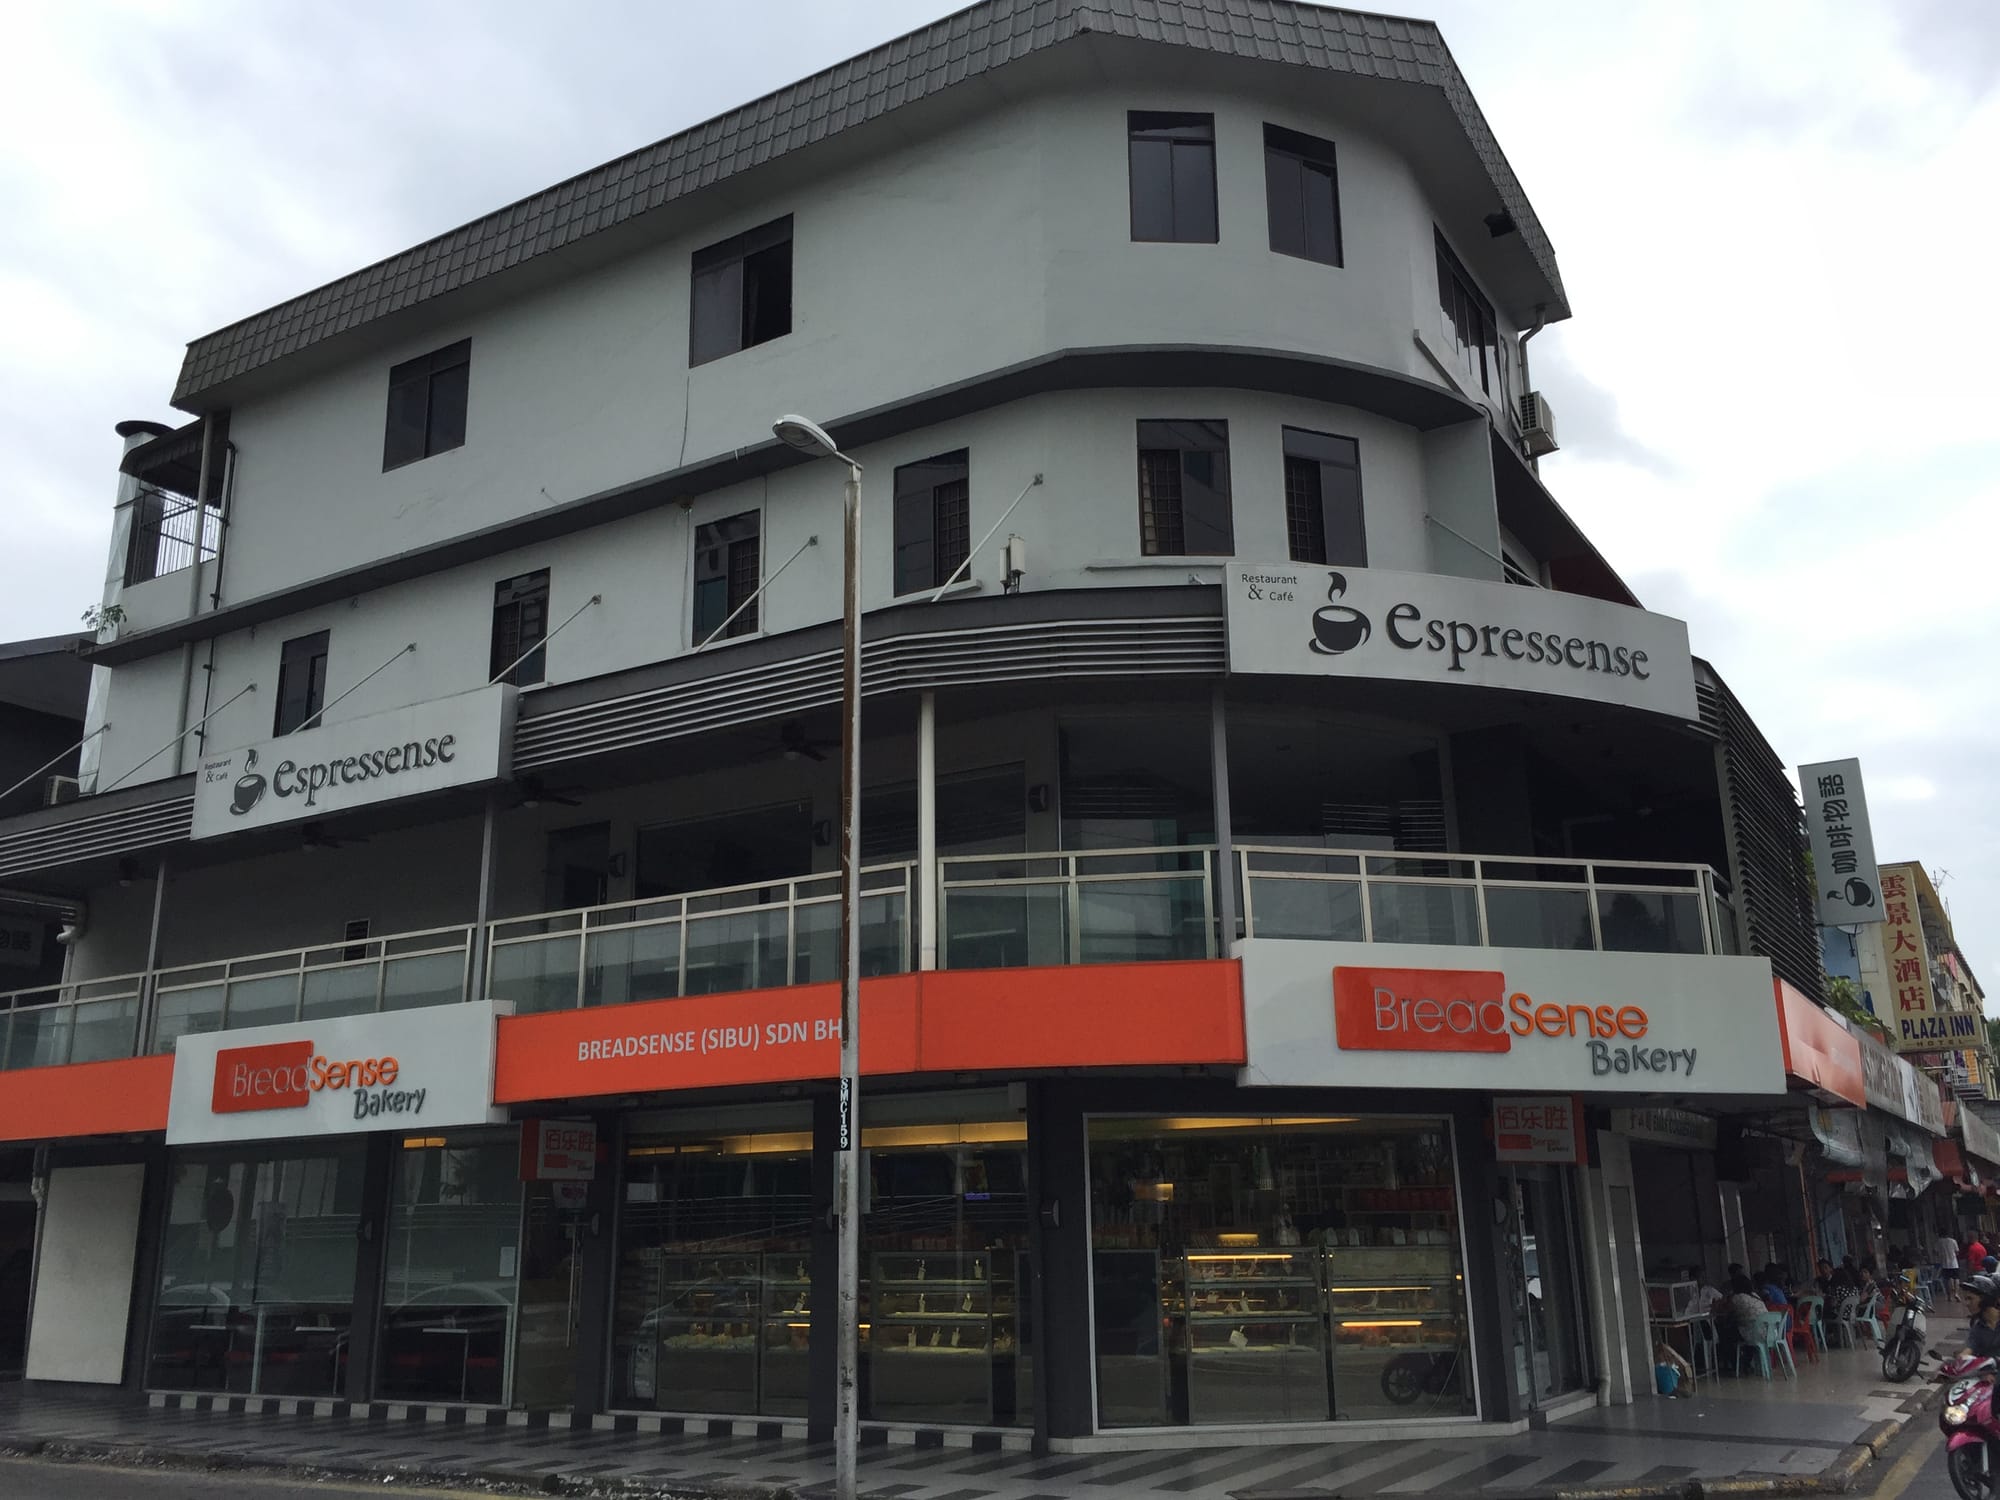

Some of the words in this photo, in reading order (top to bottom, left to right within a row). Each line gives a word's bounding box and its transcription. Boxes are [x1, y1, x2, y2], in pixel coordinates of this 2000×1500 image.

[1241, 573, 1298, 586] Restaurant
[1248, 583, 1264, 601] &
[1269, 590, 1294, 603] Café
[1386, 602, 1651, 681] espressense
[273, 733, 457, 807] espressense
[1880, 874, 1927, 1012] 雲景大酒店
[577, 1031, 696, 1062] BREADSENSE
[700, 1023, 761, 1055] (SIBU)
[765, 1020, 808, 1046] SDN
[814, 1018, 842, 1041] BH
[1901, 1017, 1948, 1040] PLAZA
[1951, 1014, 1976, 1037] INN
[1916, 1039, 1964, 1048] HOTEL
[1586, 1040, 1698, 1077] Bakery
[353, 1088, 426, 1120] Bakery
[839, 1077, 850, 1150] SMC159
